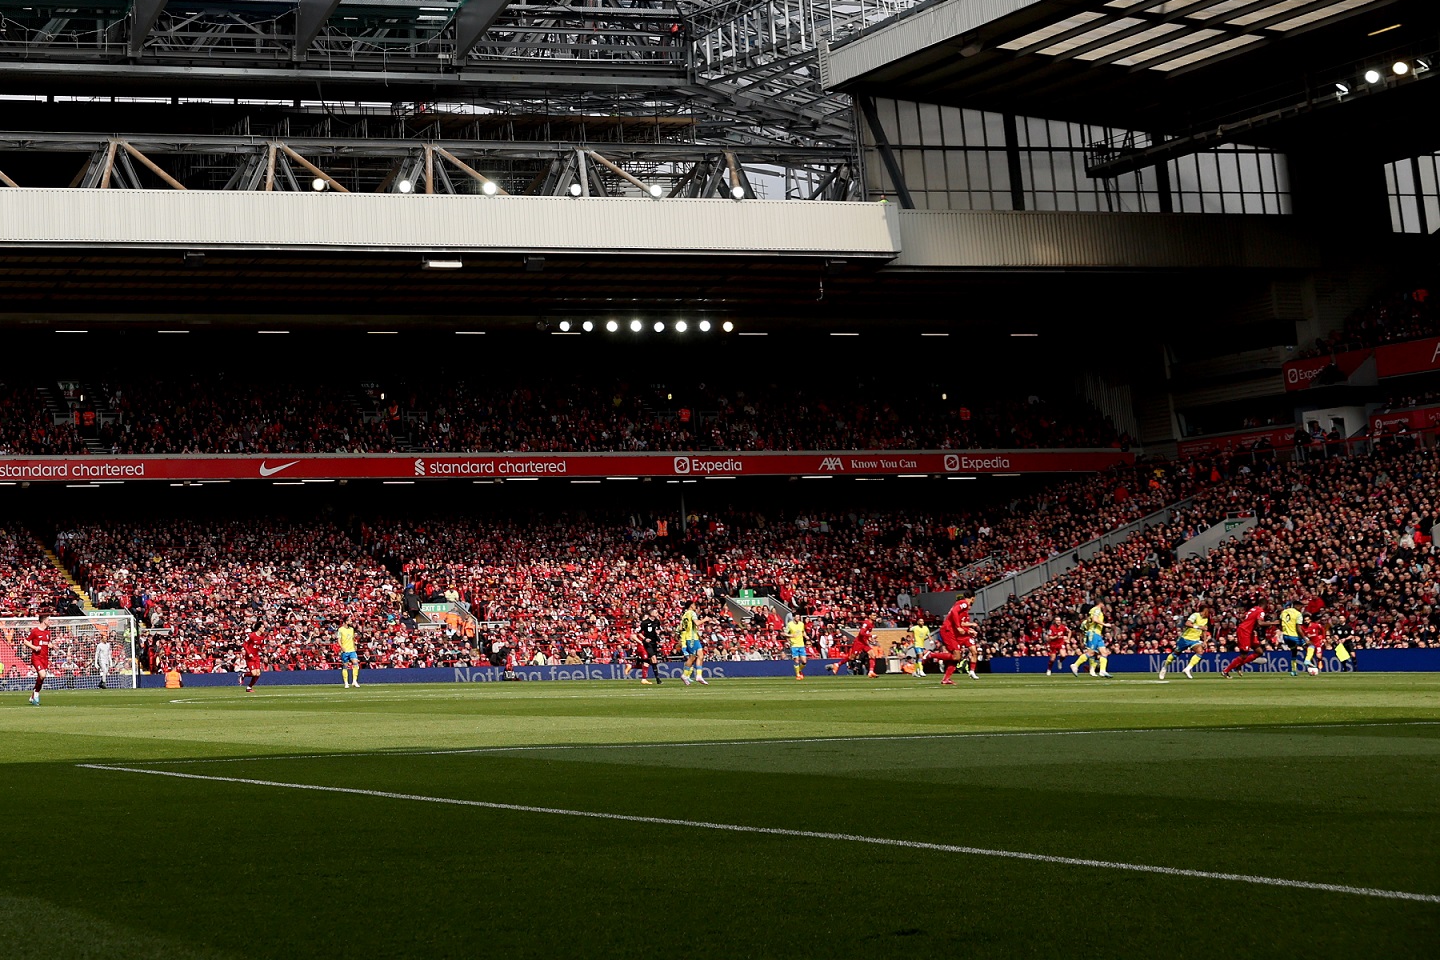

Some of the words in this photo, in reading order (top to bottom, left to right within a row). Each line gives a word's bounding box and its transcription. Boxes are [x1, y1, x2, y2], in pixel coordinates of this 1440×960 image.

[71, 462, 144, 476] chartered
[429, 460, 495, 474] standard
[498, 460, 567, 473] chartered
[692, 459, 742, 473] Expedia
[818, 457, 844, 470] AXA
[851, 459, 879, 469] Know
[880, 459, 898, 468] You
[899, 458, 917, 468] Can
[961, 457, 1010, 471] Expedia
[549, 664, 603, 681] feels
